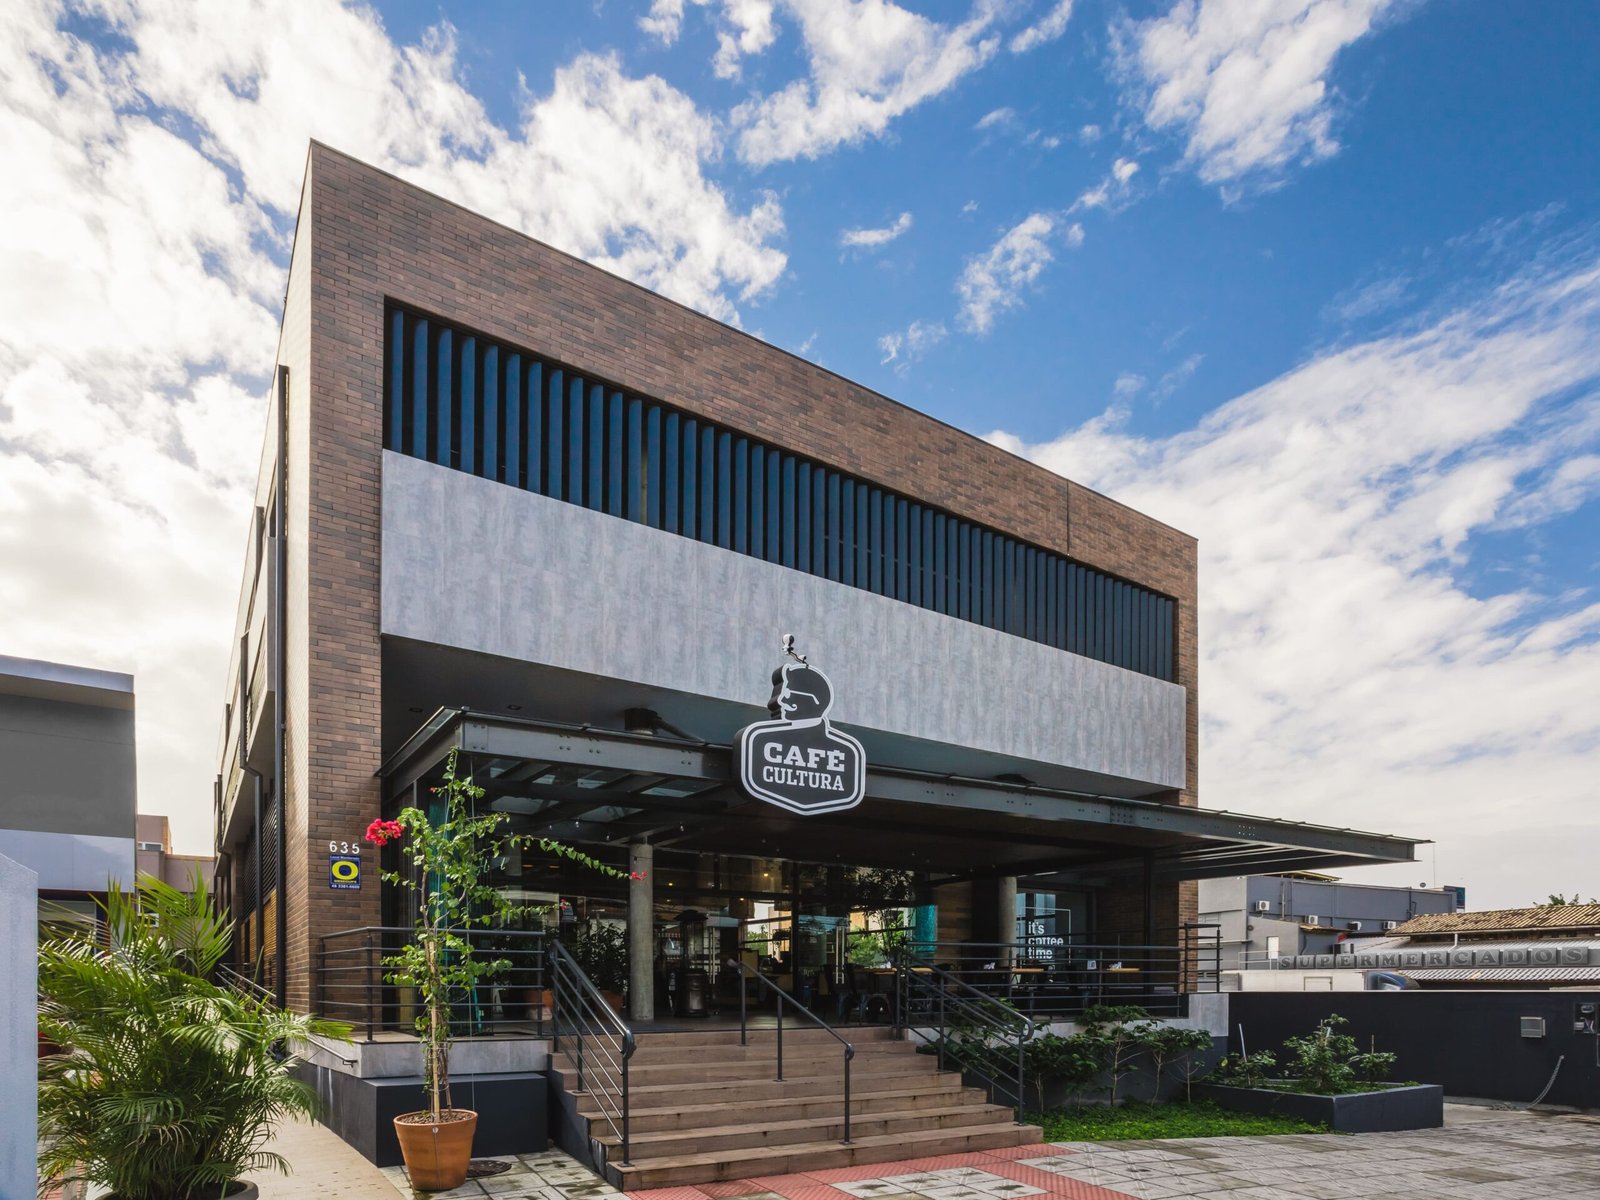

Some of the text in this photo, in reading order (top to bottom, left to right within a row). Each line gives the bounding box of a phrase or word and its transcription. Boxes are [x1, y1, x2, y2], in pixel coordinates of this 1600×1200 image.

[763, 742, 845, 773] CAFÉ
[762, 765, 845, 792] CULTURA
[329, 840, 360, 854] 635
[1028, 921, 1045, 934] it's
[1027, 947, 1053, 959] time
[1280, 948, 1583, 967] SUPERMERCADOS
